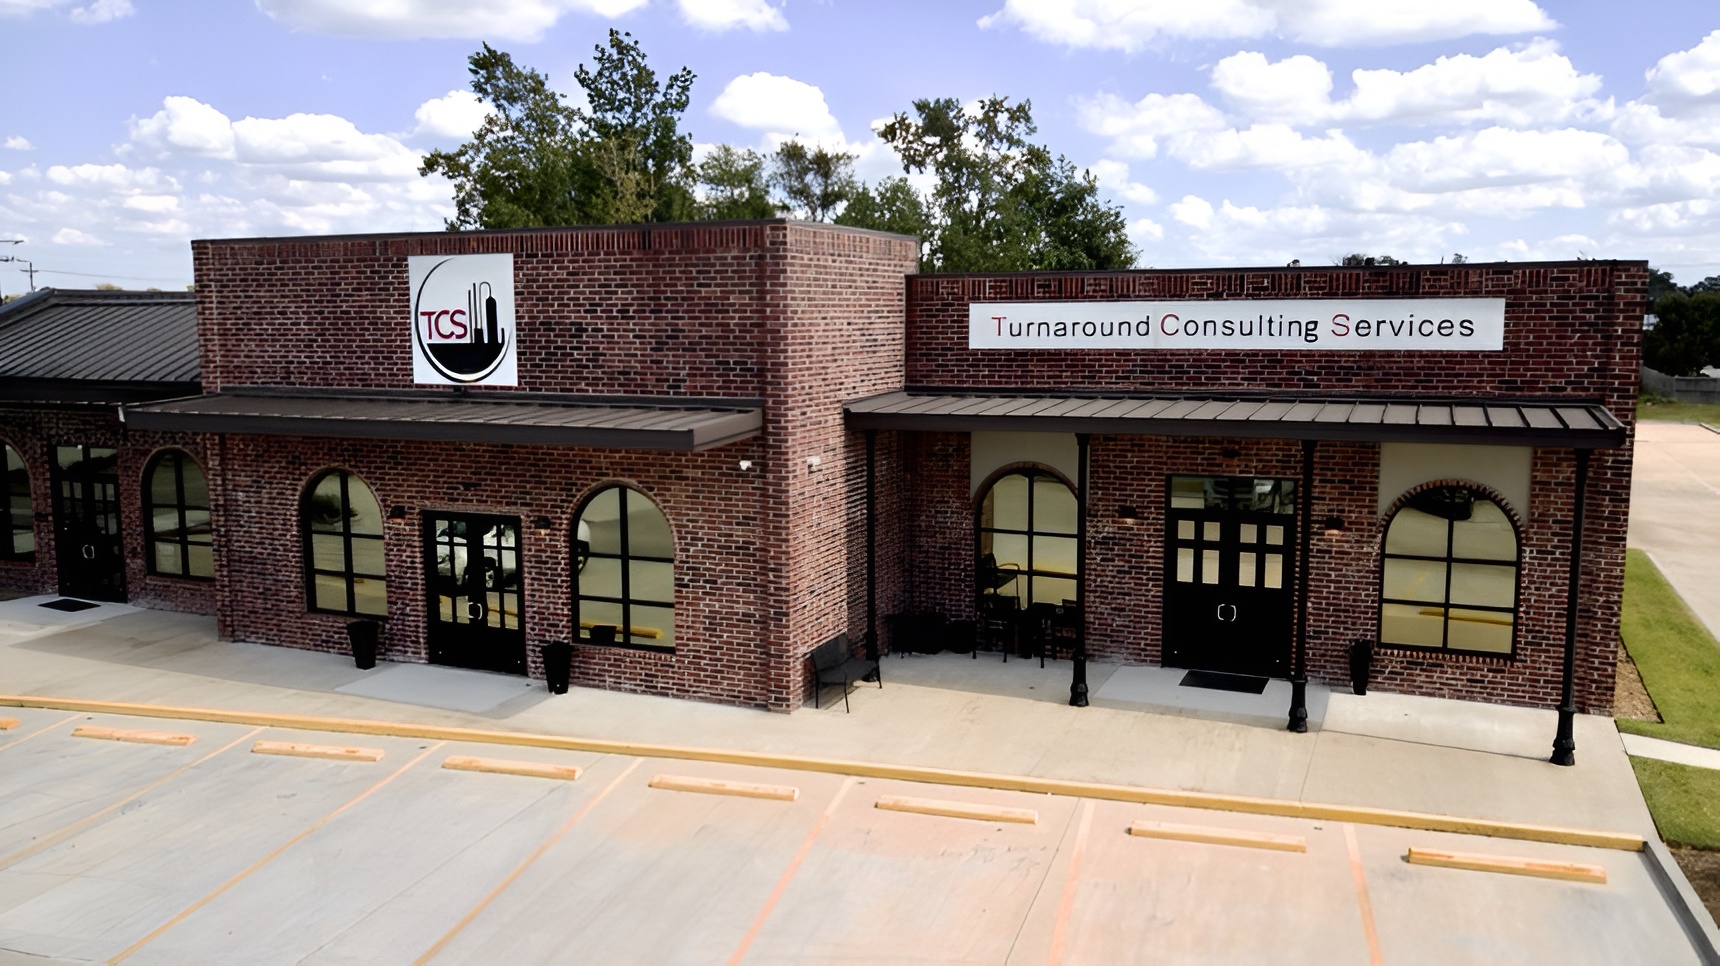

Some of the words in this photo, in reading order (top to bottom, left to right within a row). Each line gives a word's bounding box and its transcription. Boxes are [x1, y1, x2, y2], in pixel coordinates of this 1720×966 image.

[420, 309, 468, 340] TCS
[991, 315, 1151, 337] Turnaround
[1159, 313, 1319, 342] Consulting
[1331, 313, 1475, 337] Services
